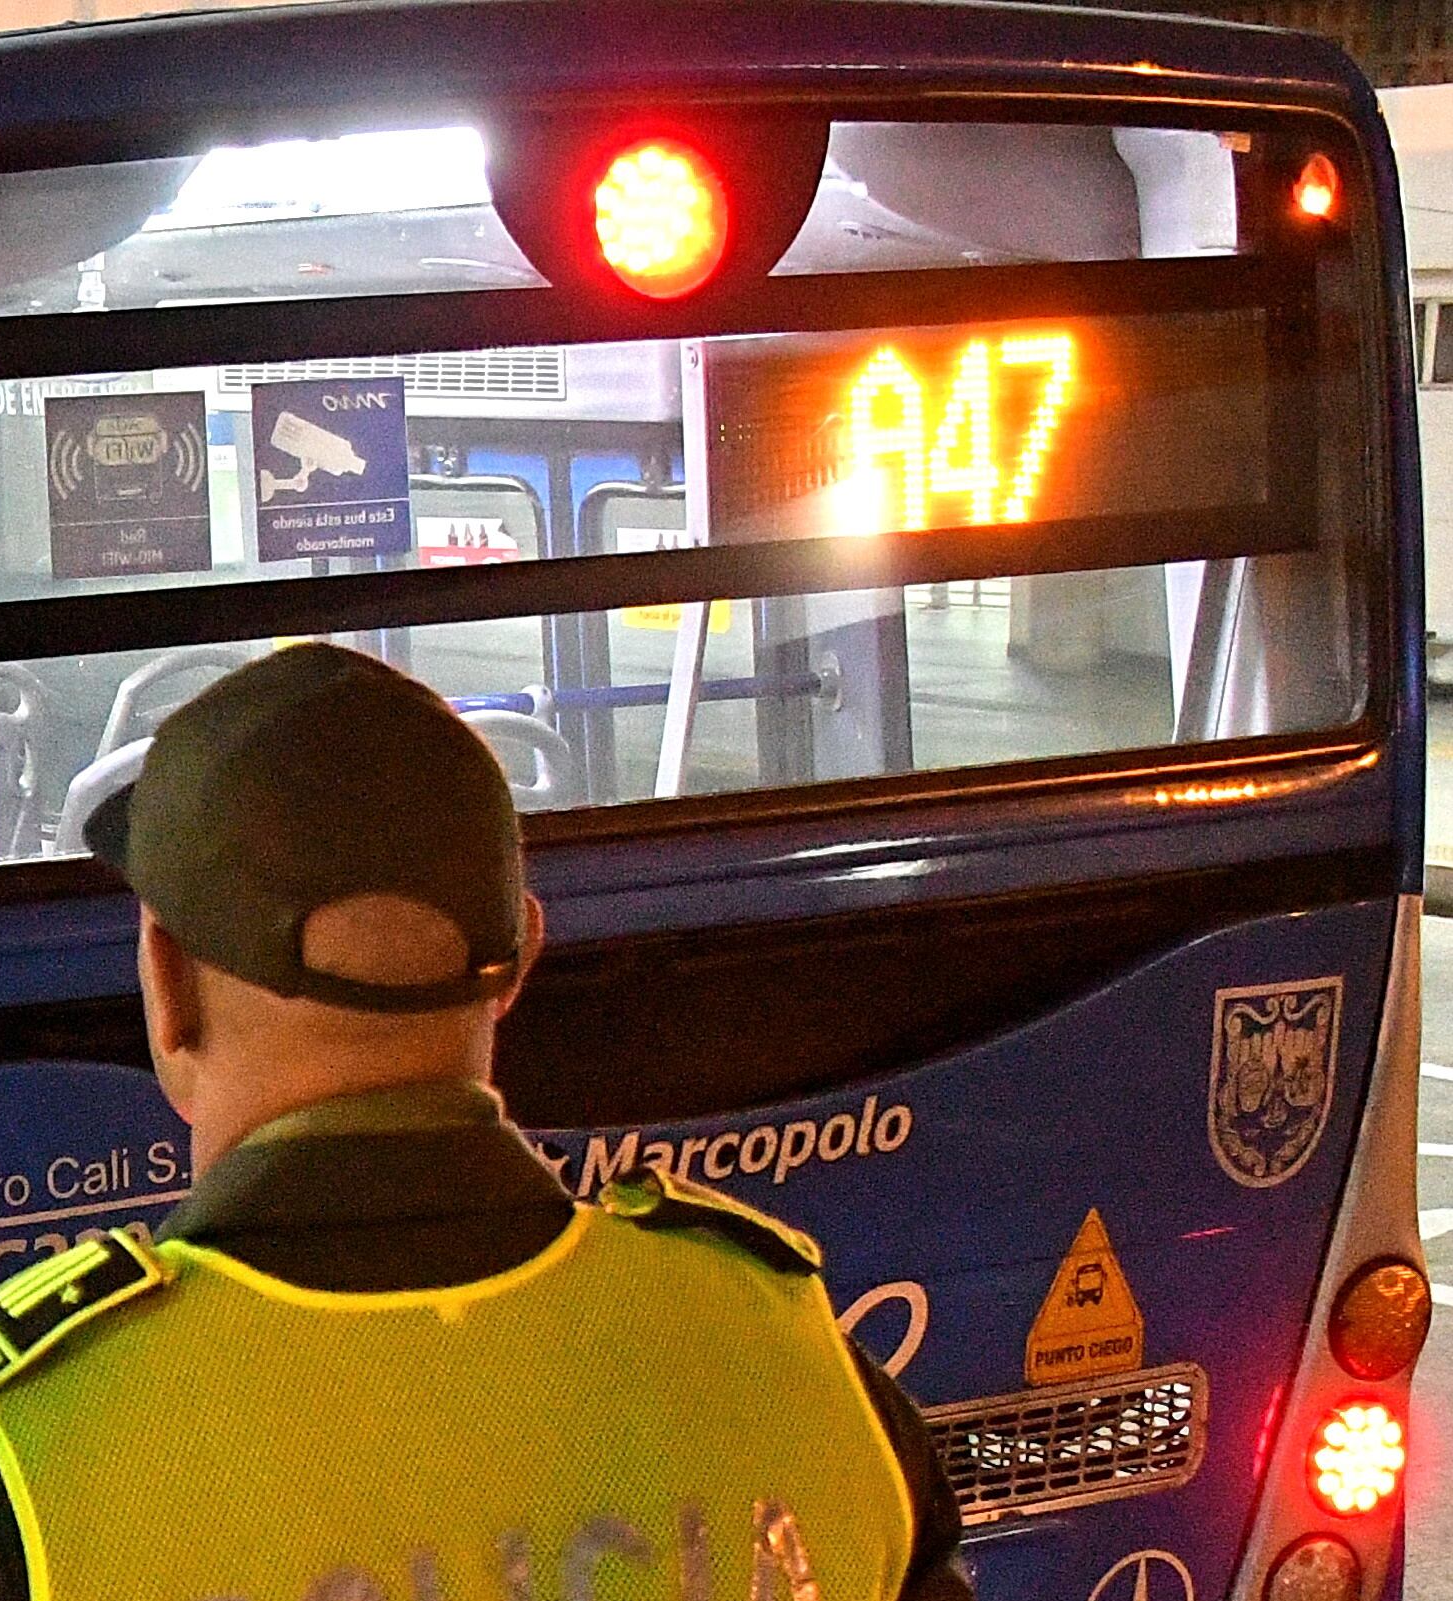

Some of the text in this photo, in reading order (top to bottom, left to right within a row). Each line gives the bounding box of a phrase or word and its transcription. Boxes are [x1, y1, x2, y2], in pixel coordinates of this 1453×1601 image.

[846, 331, 1077, 533] A47
[46, 1148, 131, 1199] Cali
[576, 1094, 914, 1198] Marcopolo
[1035, 1336, 1133, 1368] PUNTO CIEGO
